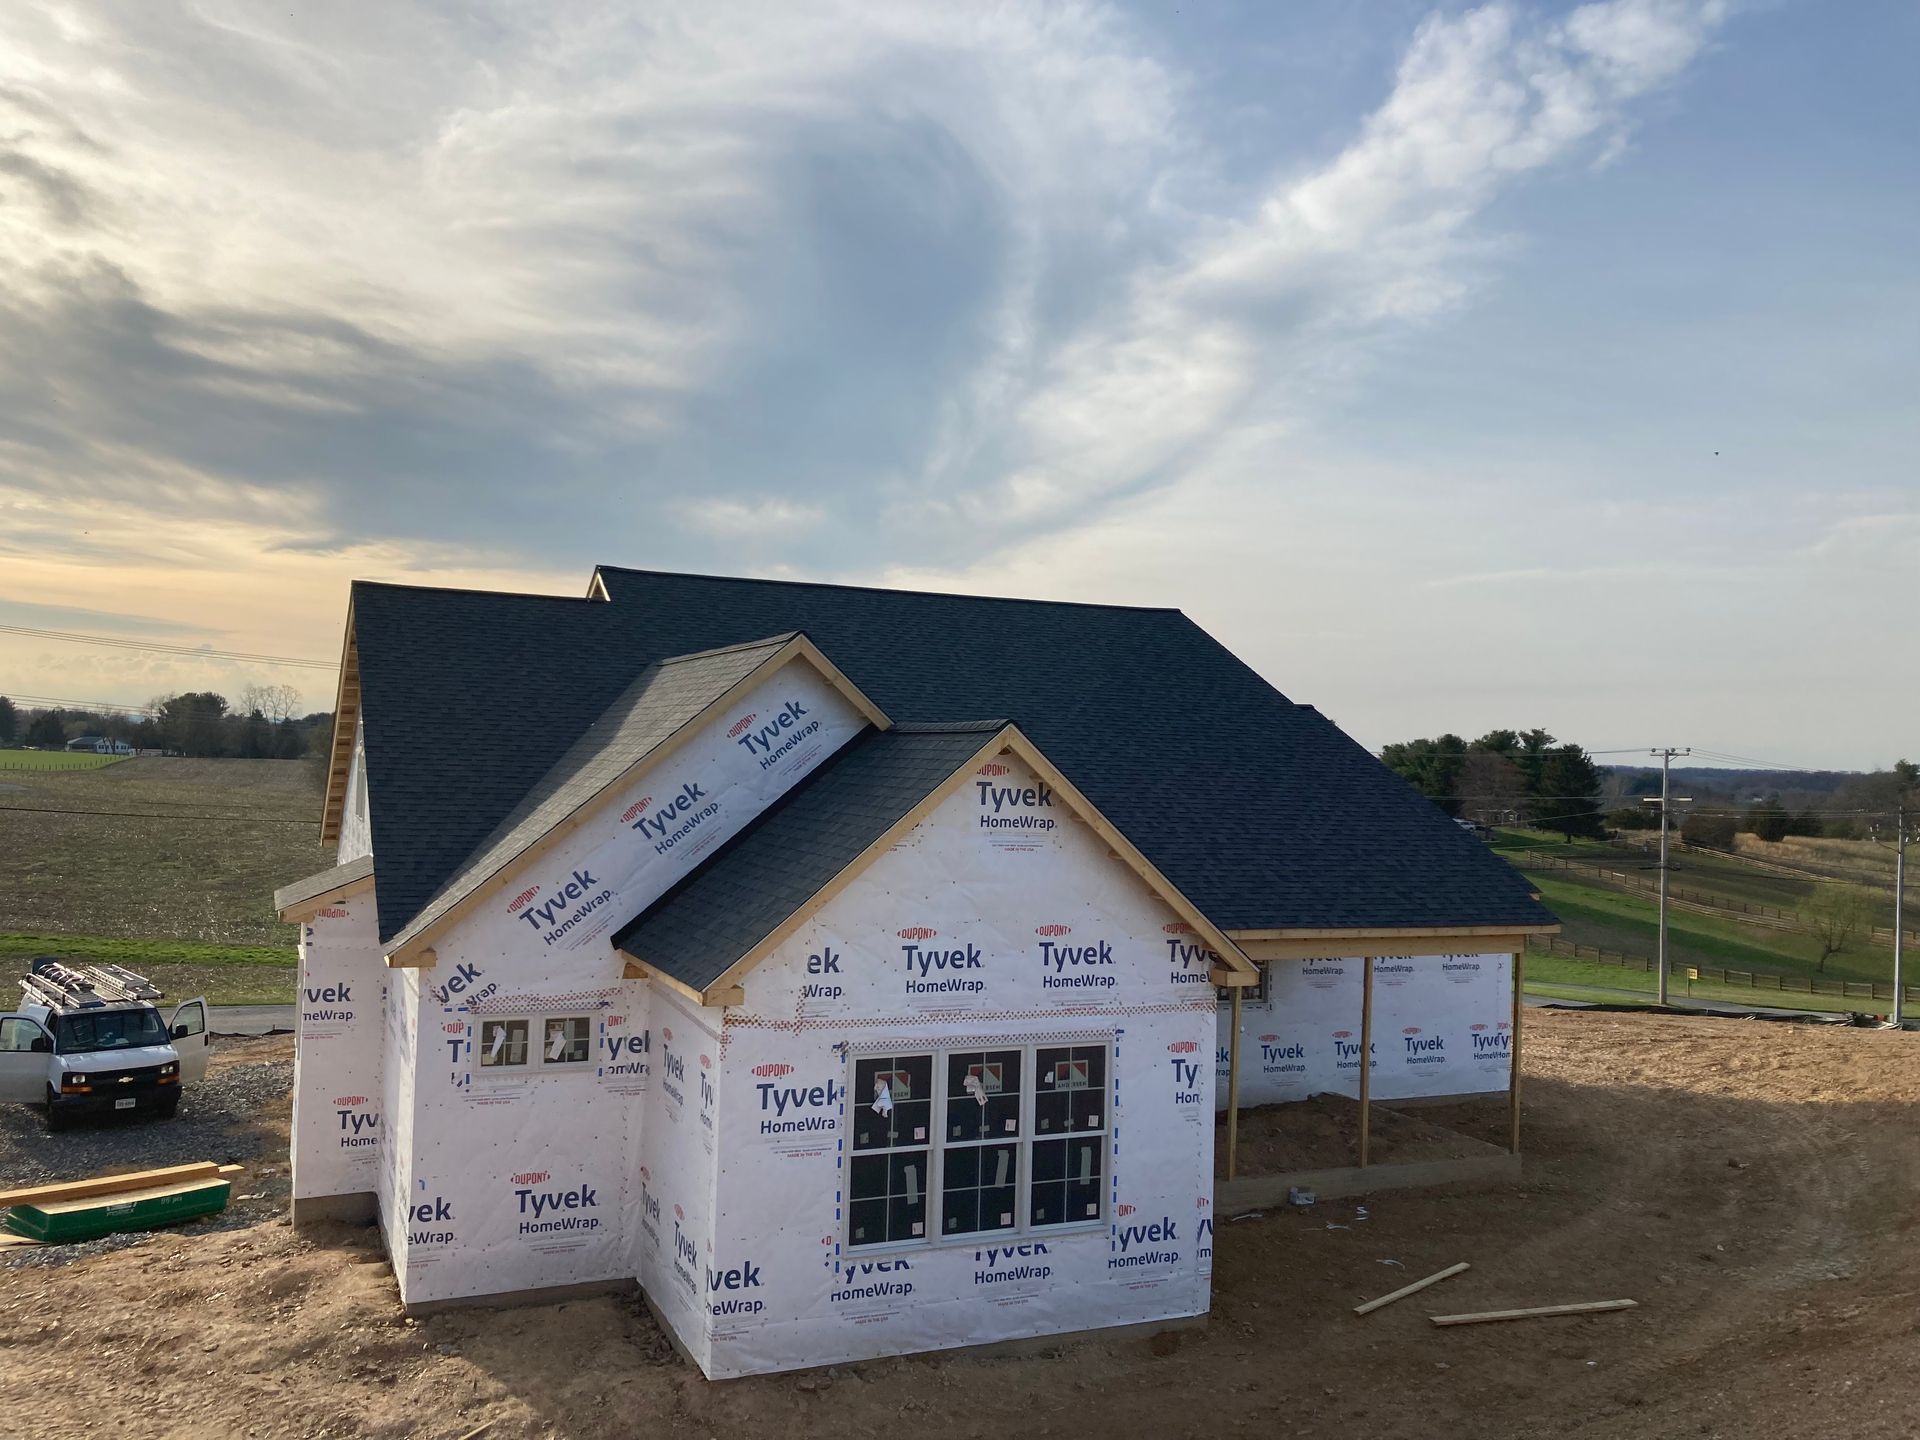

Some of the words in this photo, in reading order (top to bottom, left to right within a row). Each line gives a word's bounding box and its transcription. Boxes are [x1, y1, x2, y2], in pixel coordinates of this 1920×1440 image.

[738, 699, 807, 755] Tyvek
[759, 719, 820, 770] HomeWrap
[976, 782, 1052, 812] Tyvek
[632, 781, 706, 840] Tyvek
[654, 800, 719, 855] HomeWrap
[980, 815, 1055, 831] HomeWrap
[519, 867, 599, 931] Tyvek
[543, 887, 612, 946] HomeWrap
[901, 927, 933, 940] DUPONT
[1039, 924, 1068, 936] DUPONT
[902, 943, 982, 977] Tyvek
[1039, 940, 1113, 972] Tyvek
[906, 979, 984, 993] HomeWrap
[1043, 974, 1115, 988] HomeWrap
[303, 982, 351, 1003] vek
[1171, 1041, 1198, 1053] DUPONT
[1261, 1043, 1304, 1063] Tyvek
[1405, 1036, 1444, 1055] Tyvek
[1406, 1055, 1445, 1064] HomeWrap
[756, 1064, 791, 1077] DUPONT
[1264, 1064, 1306, 1074] HomeWrap
[337, 1096, 365, 1106] DUPONT
[761, 1117, 836, 1134] HomeWra
[515, 1172, 547, 1184] DUPONT
[515, 1184, 597, 1218] Tyvek
[519, 1217, 599, 1234] HomeWrap
[974, 1266, 1051, 1284] HomeWrap
